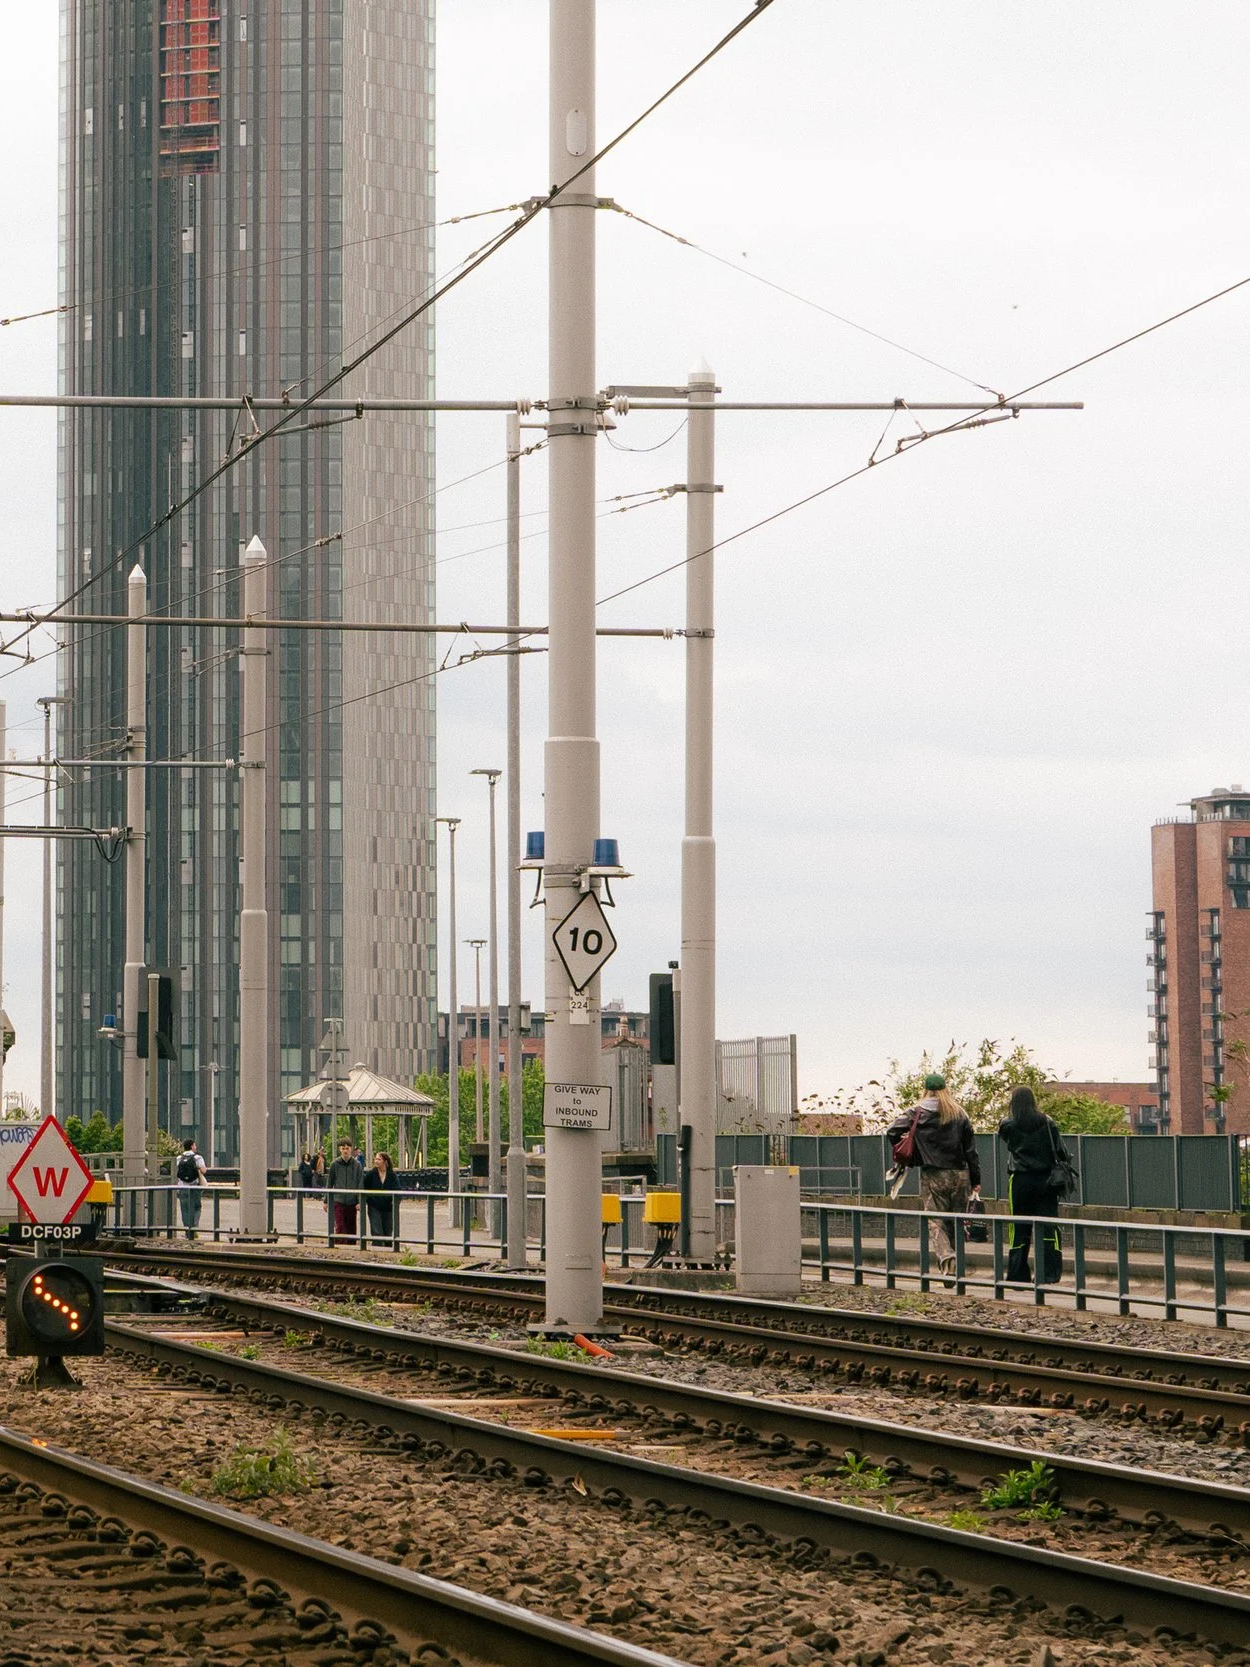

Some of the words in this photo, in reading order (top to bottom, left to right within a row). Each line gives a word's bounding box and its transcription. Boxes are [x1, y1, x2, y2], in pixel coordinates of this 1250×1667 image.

[569, 927, 603, 955] 10
[570, 1000, 588, 1009] 224
[554, 1085, 578, 1094] GIVE
[579, 1086, 601, 1096] WAY
[572, 1098, 582, 1106] to
[555, 1107, 598, 1118] INBOUND
[560, 1118, 593, 1128] TRAMS
[32, 1167, 69, 1197] W
[21, 1225, 82, 1239] DCF03P
